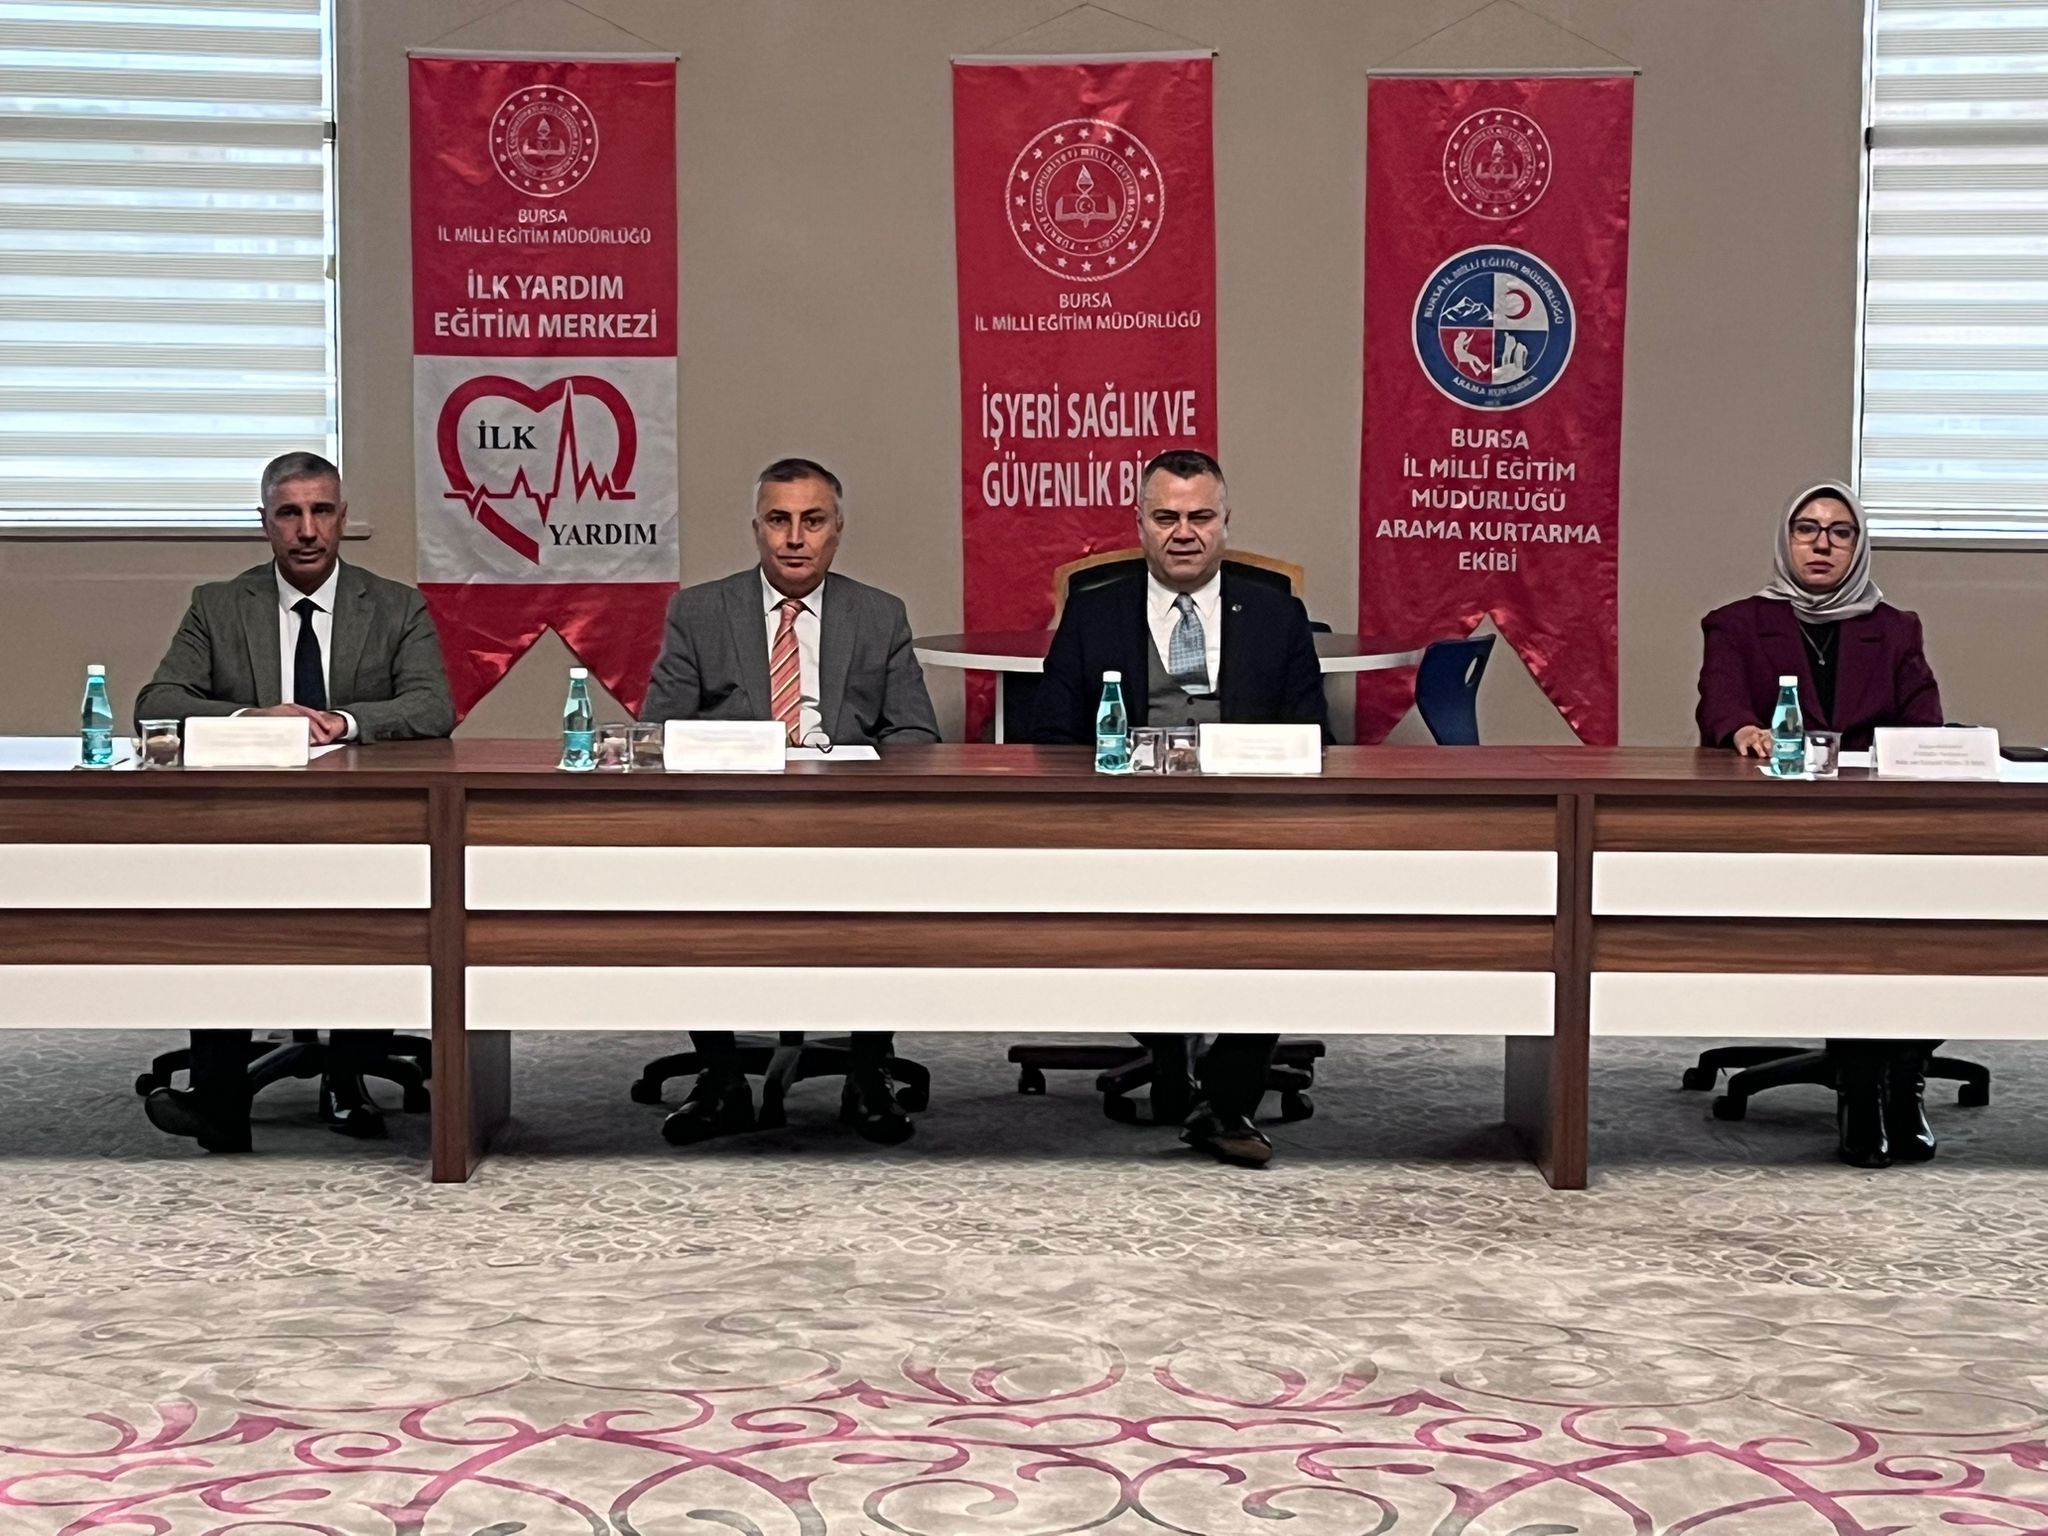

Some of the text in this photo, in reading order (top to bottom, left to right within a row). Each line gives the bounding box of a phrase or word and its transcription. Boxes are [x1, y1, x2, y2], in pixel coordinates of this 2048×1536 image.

[518, 209, 568, 224] BURSA
[438, 224, 451, 242] İL
[498, 226, 549, 244] EĞİTİM
[552, 227, 651, 244] MÜDÜRLÜĞÜ
[467, 269, 624, 300] İLK YARDIM
[1059, 292, 1112, 309] BURSA
[434, 306, 658, 339] EĞİTİM MERKEZİ
[975, 313, 988, 331] İL
[1038, 312, 1092, 331] EĞİTİM
[1096, 309, 1201, 330] MÜDÜRLÜĞÜ
[1452, 375, 1486, 396] ARAMA
[982, 381, 1196, 451] İŞYERİ SAĞLIK VE
[477, 419, 537, 450] İLK
[1451, 428, 1530, 450] BURSA
[982, 450, 1113, 507] GÜVENLİK
[1403, 453, 1423, 478] İL
[1496, 455, 1576, 482] EĞİTİM
[1411, 484, 1566, 512] MÜDÜRLÜĞÜ
[549, 523, 657, 546] YARDIM
[1376, 519, 1602, 545] ARAMA KURTARMA
[1458, 548, 1517, 573] EKİBİ
